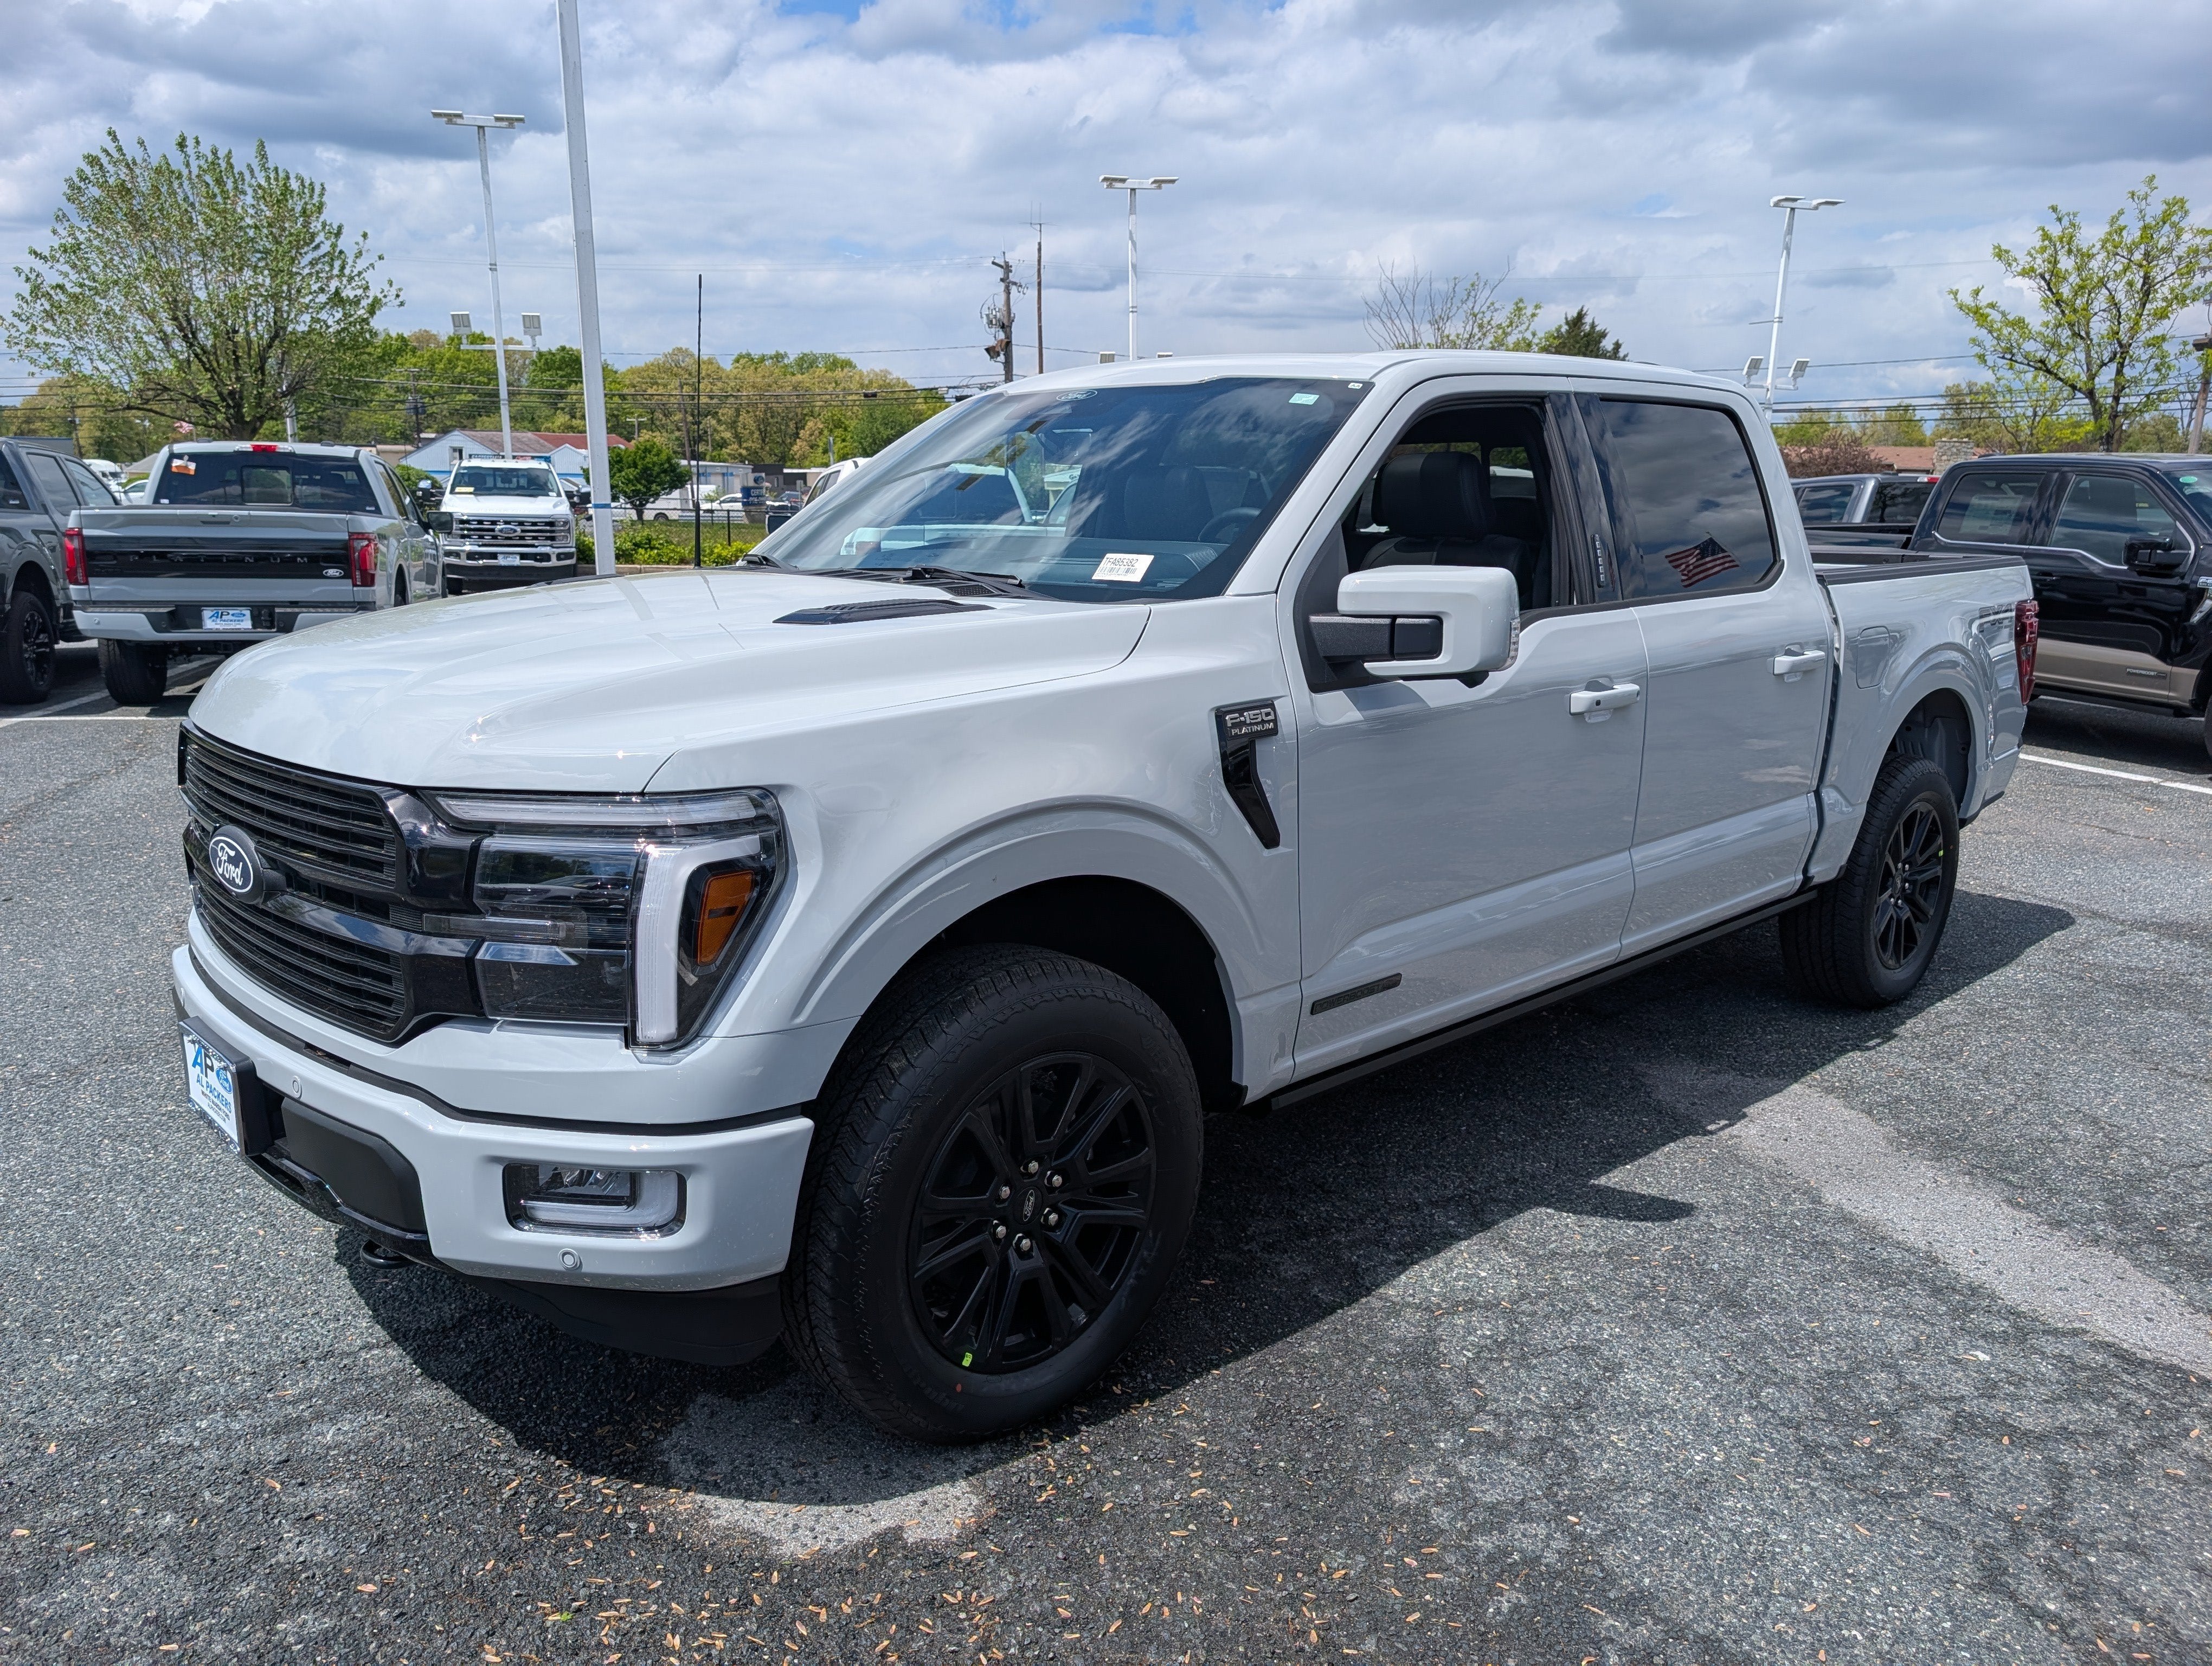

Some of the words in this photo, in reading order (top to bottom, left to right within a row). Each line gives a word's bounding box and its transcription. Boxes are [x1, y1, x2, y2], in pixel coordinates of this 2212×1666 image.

[130, 555, 308, 563] PLATINUM
[1103, 558, 1139, 567] TFA85382
[1978, 603, 2014, 633] FX4
[1225, 708, 1275, 727] F-150
[1231, 722, 1274, 736] PLATINUM
[216, 842, 243, 886] Ford
[192, 1046, 215, 1079] AP
[218, 1069, 230, 1091] Ford
[196, 1073, 204, 1088] AL
[205, 1080, 232, 1114] PACKERS
